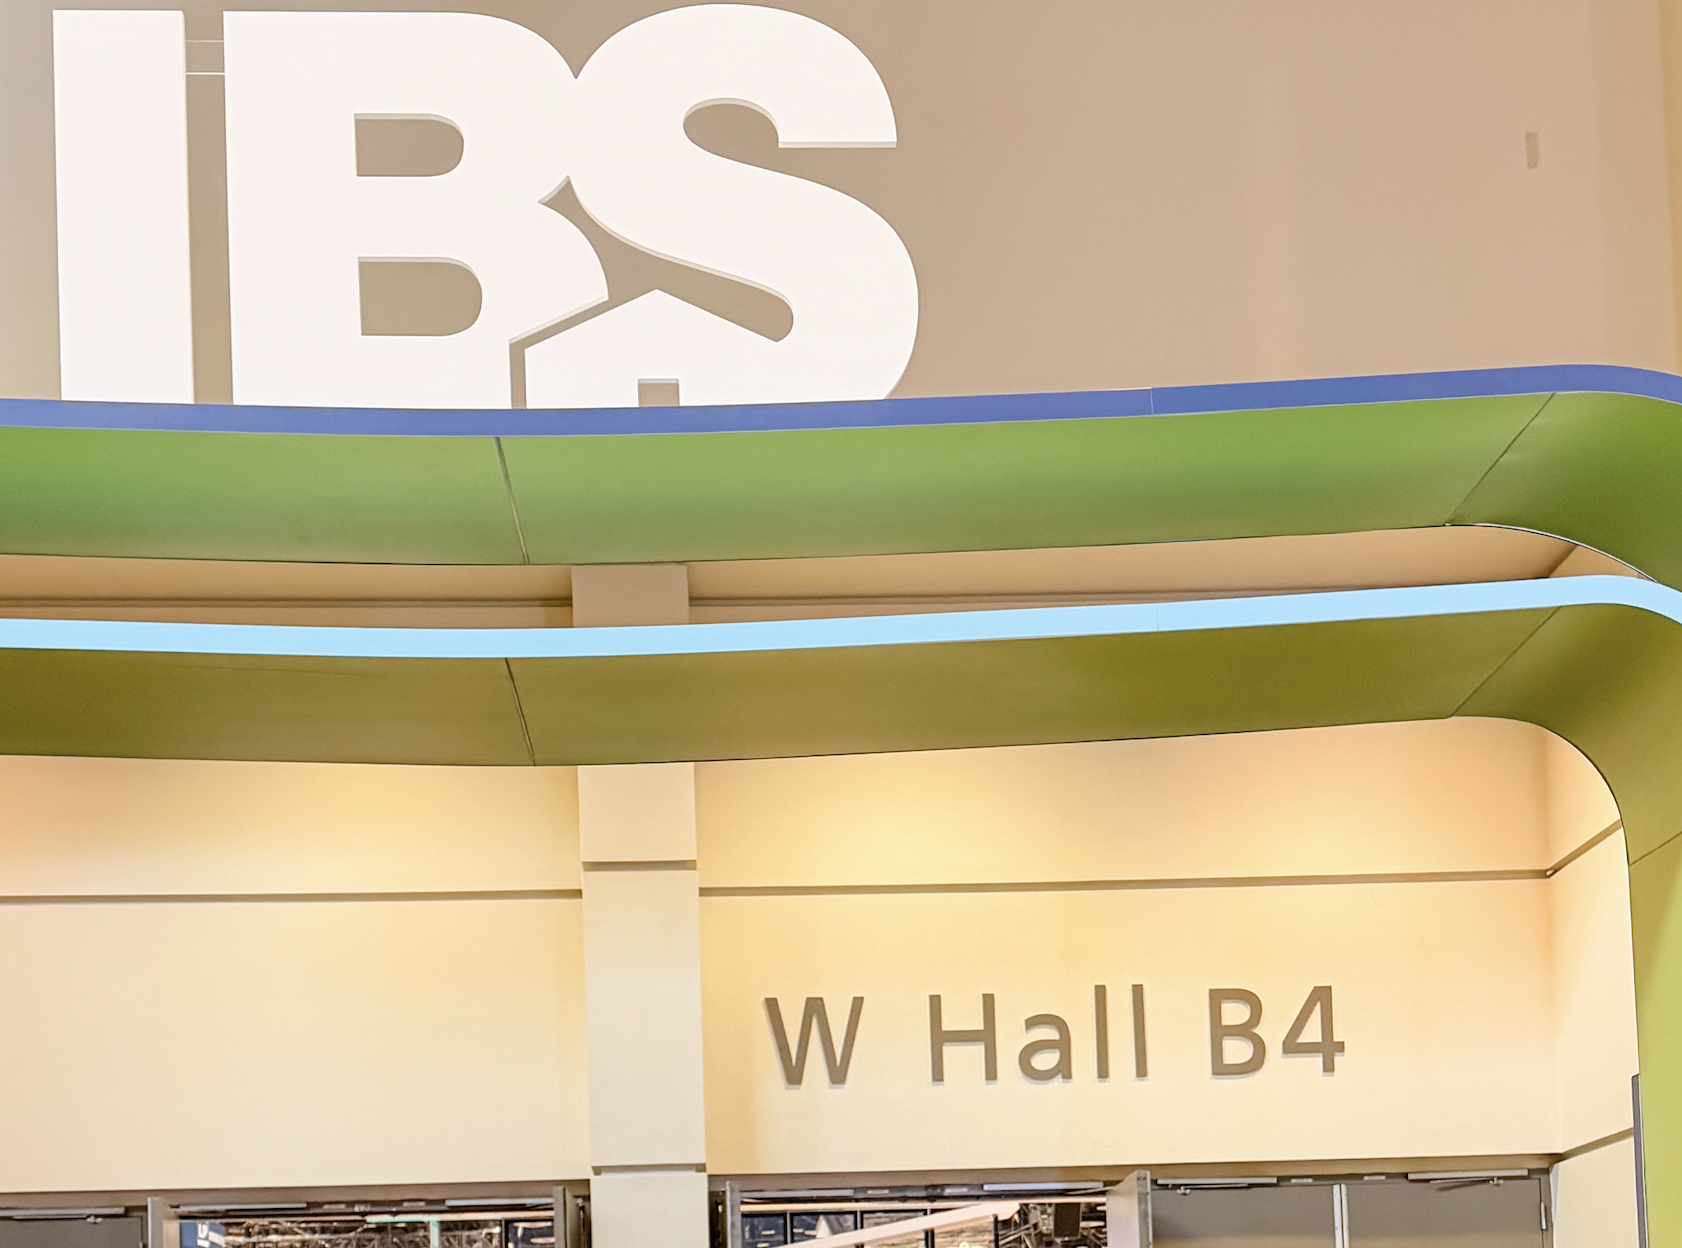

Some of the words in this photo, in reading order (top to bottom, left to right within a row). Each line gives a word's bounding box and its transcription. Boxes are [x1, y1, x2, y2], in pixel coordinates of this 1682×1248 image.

[52, 3, 920, 410] IBS
[764, 996, 864, 1086] W
[928, 983, 1149, 1083] Hall
[1208, 985, 1345, 1078] B4
